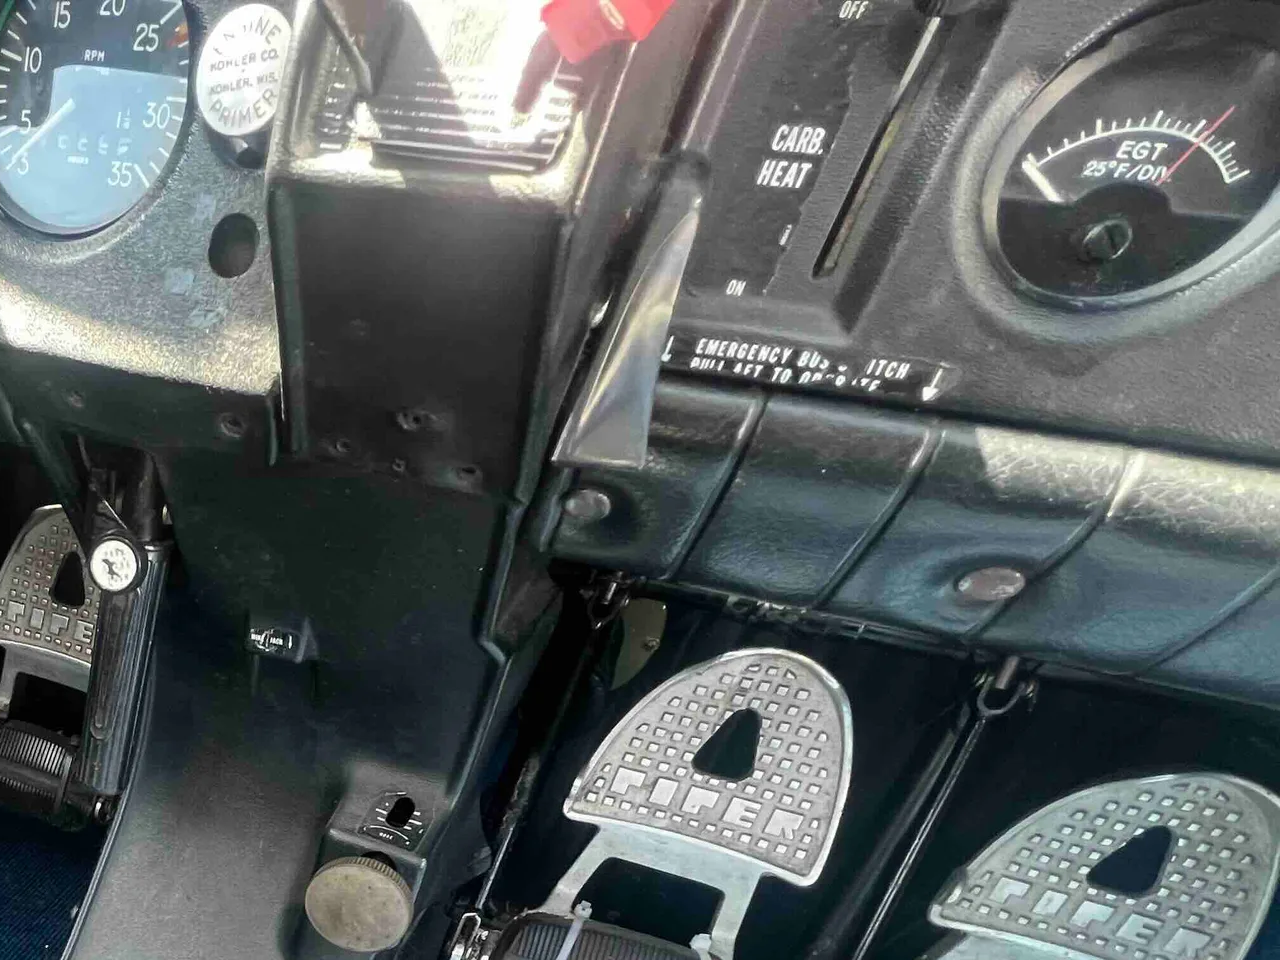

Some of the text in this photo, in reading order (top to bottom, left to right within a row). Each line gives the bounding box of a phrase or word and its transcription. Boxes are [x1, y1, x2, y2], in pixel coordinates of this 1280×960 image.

[53, 1, 71, 29] 15
[99, 0, 125, 16] 20
[839, 0, 869, 19] OFF
[133, 23, 160, 52] 25
[24, 47, 42, 73] 10
[84, 50, 106, 62] RPM
[210, 53, 256, 72] KOHLER
[142, 102, 170, 129] 30
[209, 88, 278, 128] PRIMER
[20, 110, 31, 134] 5
[771, 124, 826, 155] CARB.
[1116, 140, 1168, 162] EGT
[107, 161, 133, 187] 35
[756, 159, 812, 189] HEAT
[726, 280, 745, 297] ON
[695, 338, 794, 366] EMERGENCY
[733, 363, 764, 378] AFT
[771, 367, 792, 384] TO
[6, 600, 96, 644] PIPE
[609, 766, 805, 840] PIPER
[990, 876, 1214, 958] PIPER
